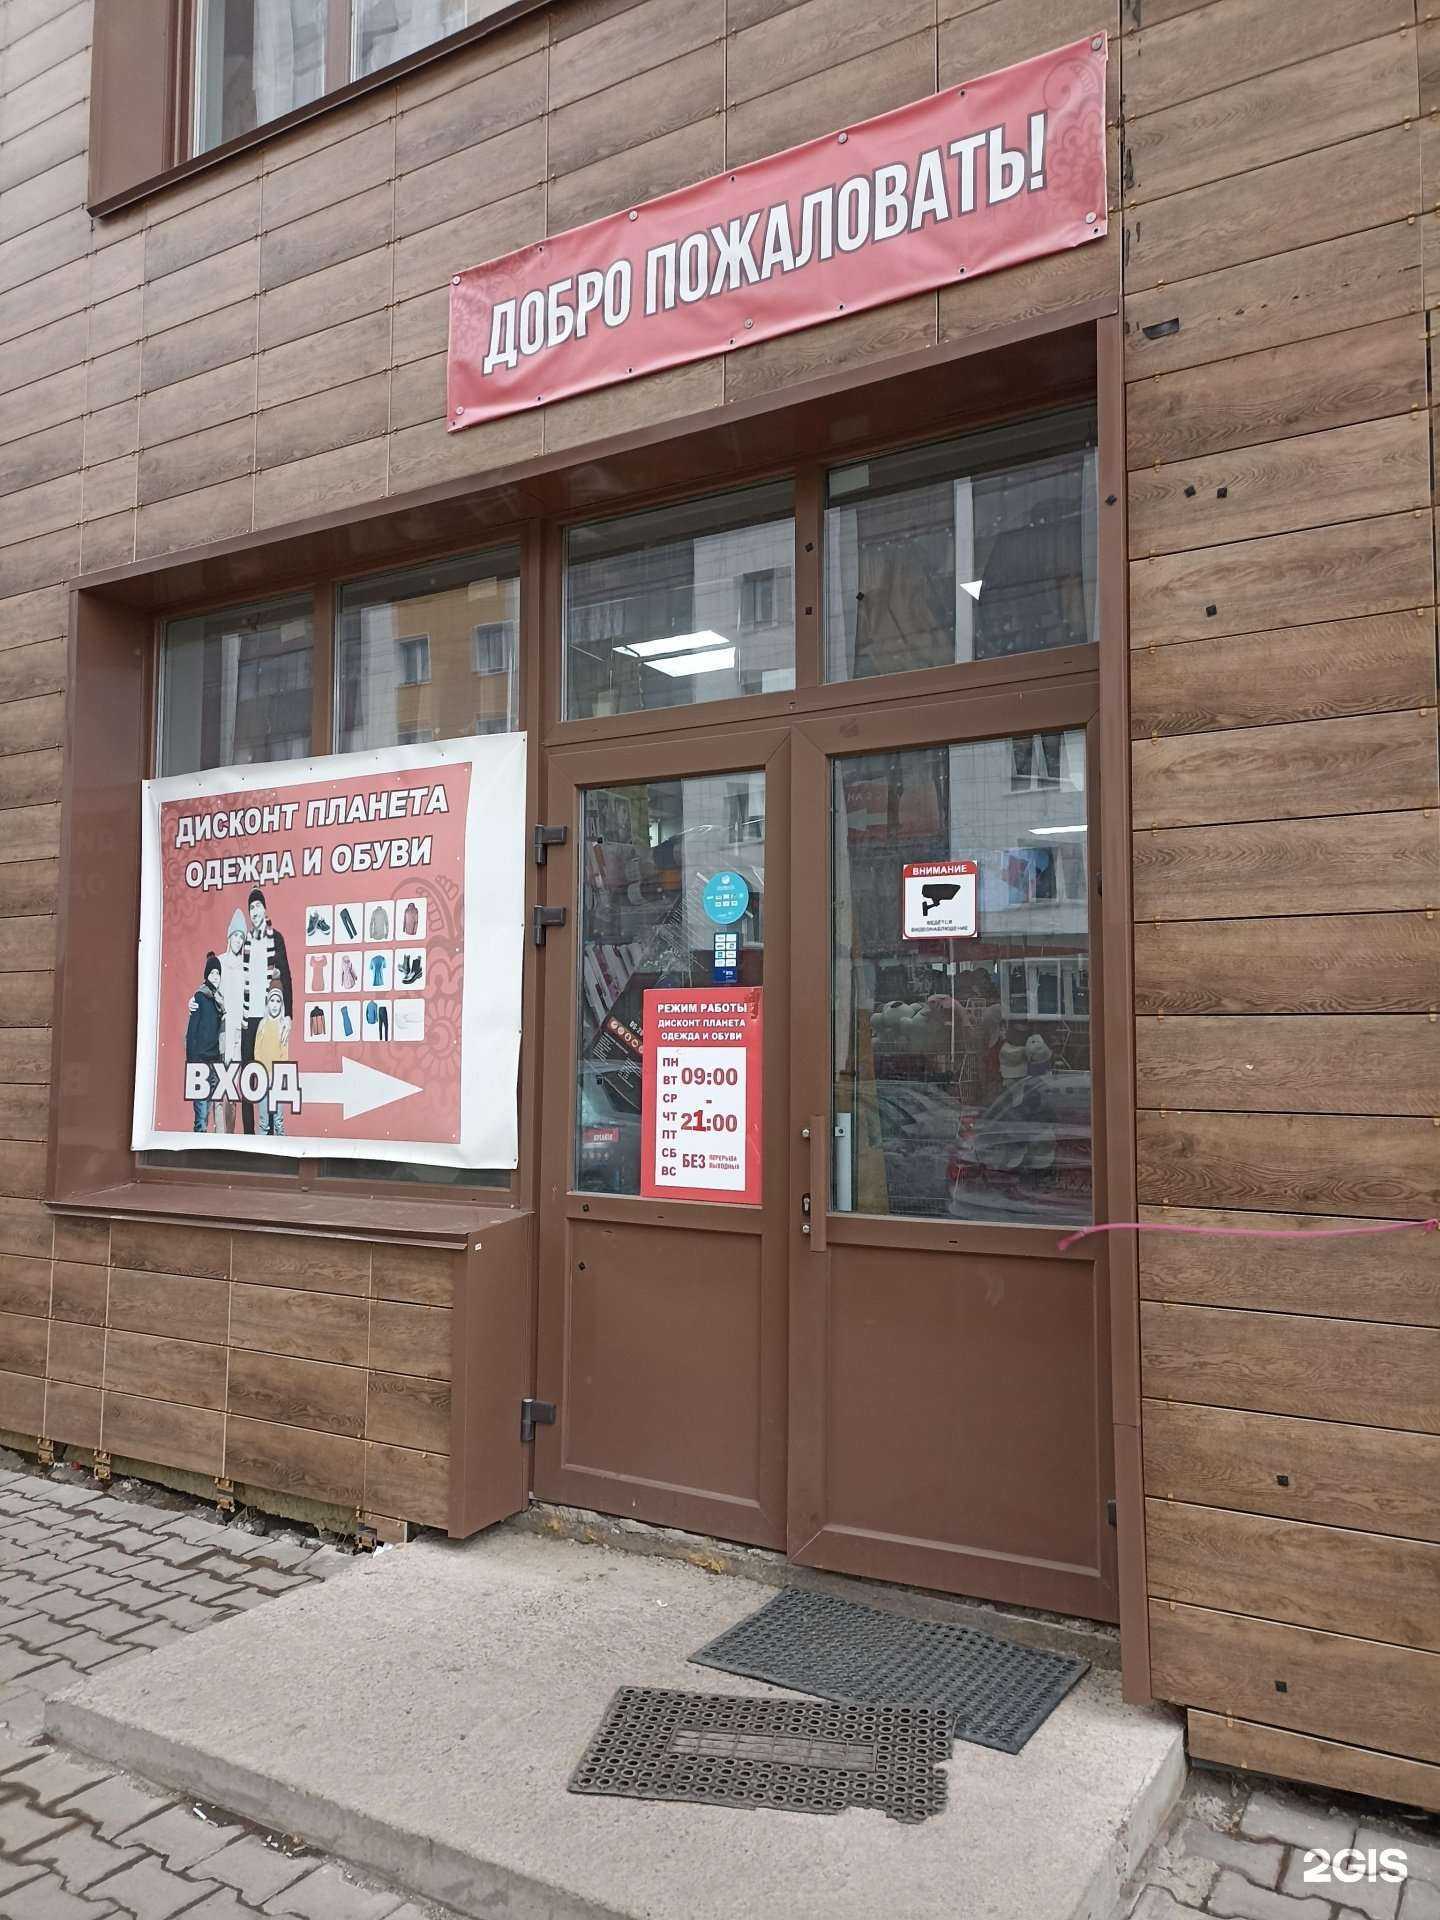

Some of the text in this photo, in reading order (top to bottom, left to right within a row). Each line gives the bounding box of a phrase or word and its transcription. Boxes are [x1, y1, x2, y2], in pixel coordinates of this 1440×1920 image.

[482, 111, 1048, 375] ДОБРО ПОЖАЛОВАТЬ!
[175, 785, 449, 848] ДИСКОНТ ПЛАНЕТА
[185, 836, 432, 891] ОДЕЖДА И ОБУВИ
[912, 864, 968, 876] ВНИМАНИЕ
[657, 1003, 748, 1013] РЕЖИМ РАБОТЫ
[657, 1018, 746, 1028] ДИСКОНТ ПЛАНЕТА
[661, 1032, 742, 1041] ОДЕЖДА И ОБУВИ
[662, 1057, 679, 1067] ПН
[663, 1075, 678, 1085] ВТ
[681, 1067, 738, 1085] 09:00
[185, 1061, 302, 1114] ВХОД
[662, 1093, 678, 1103] СР
[662, 1112, 678, 1122] ЧТ
[680, 1110, 738, 1132] 21:00
[662, 1130, 678, 1140] ПТ
[661, 1148, 677, 1158] СБ
[682, 1153, 706, 1169] БЕЗ
[661, 1166, 677, 1177] ВС
